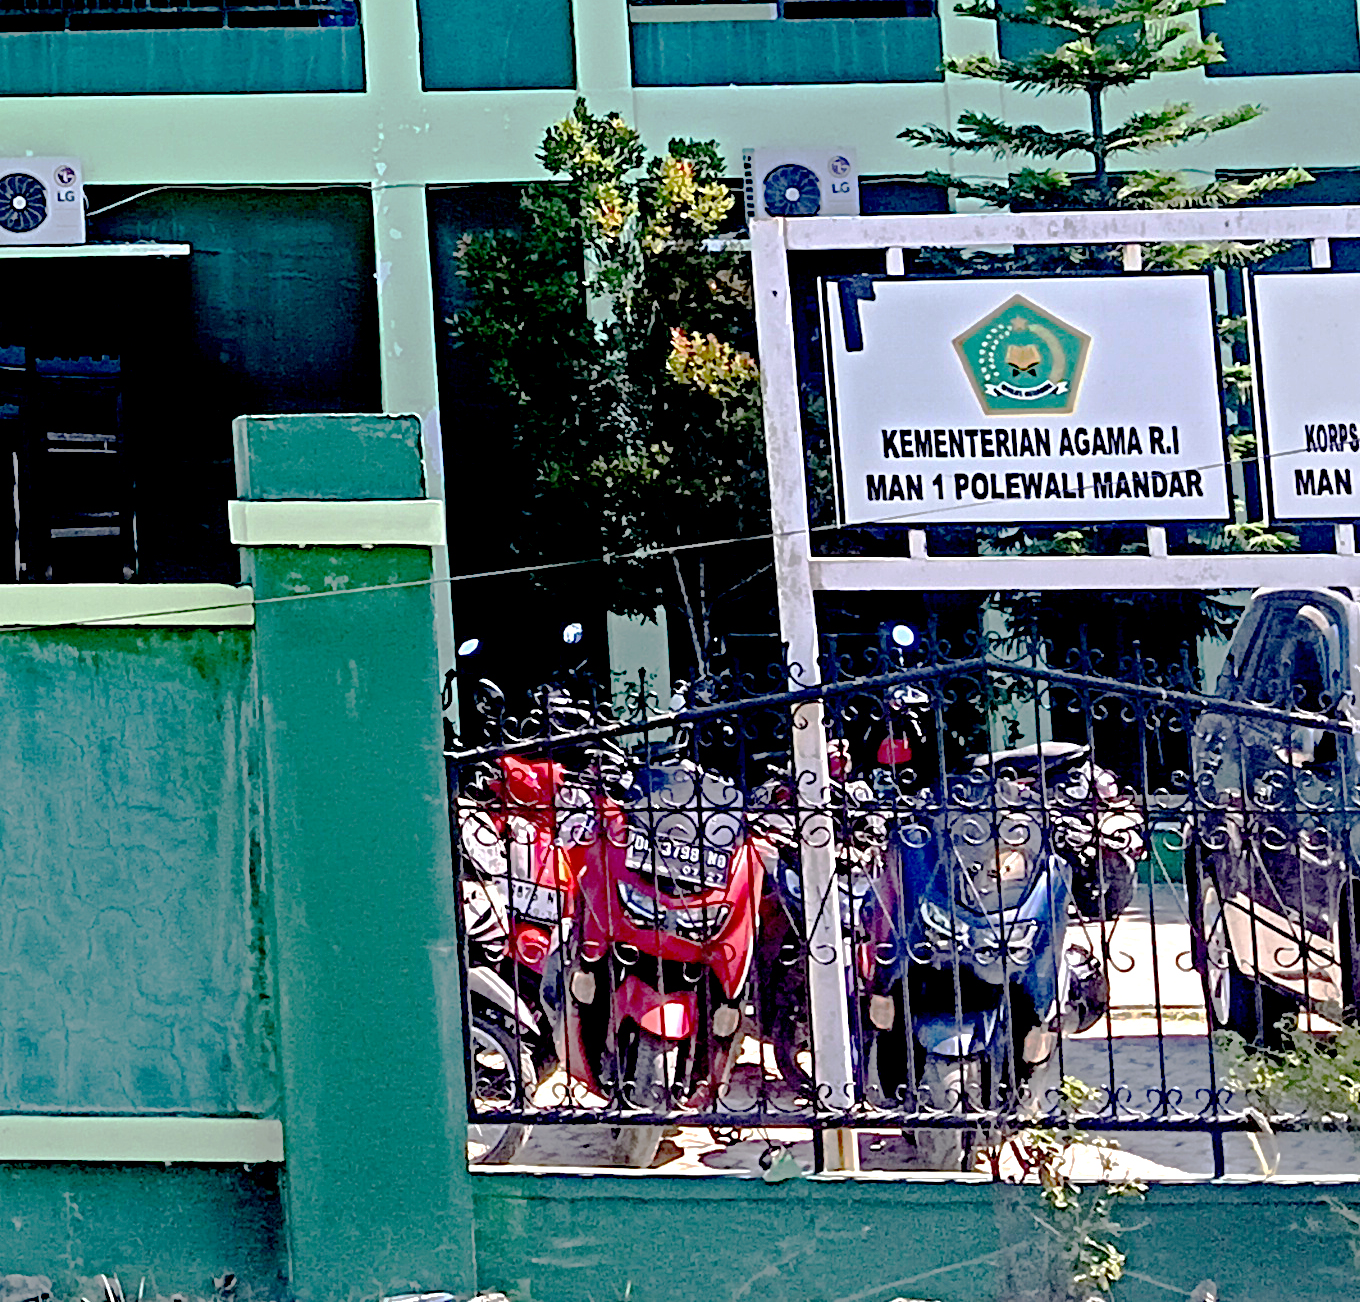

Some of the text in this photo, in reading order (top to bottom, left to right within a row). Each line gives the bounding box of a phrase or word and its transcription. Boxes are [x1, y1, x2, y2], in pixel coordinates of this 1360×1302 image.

[57, 190, 76, 203] LG
[832, 181, 851, 194] LG
[881, 425, 1180, 459] KEMENTERIAN AGAMA R.I
[1304, 423, 1360, 453] KORPS
[866, 469, 1204, 502] MAN 1 POLEWALI MANDAR
[1294, 468, 1353, 496] MAN
